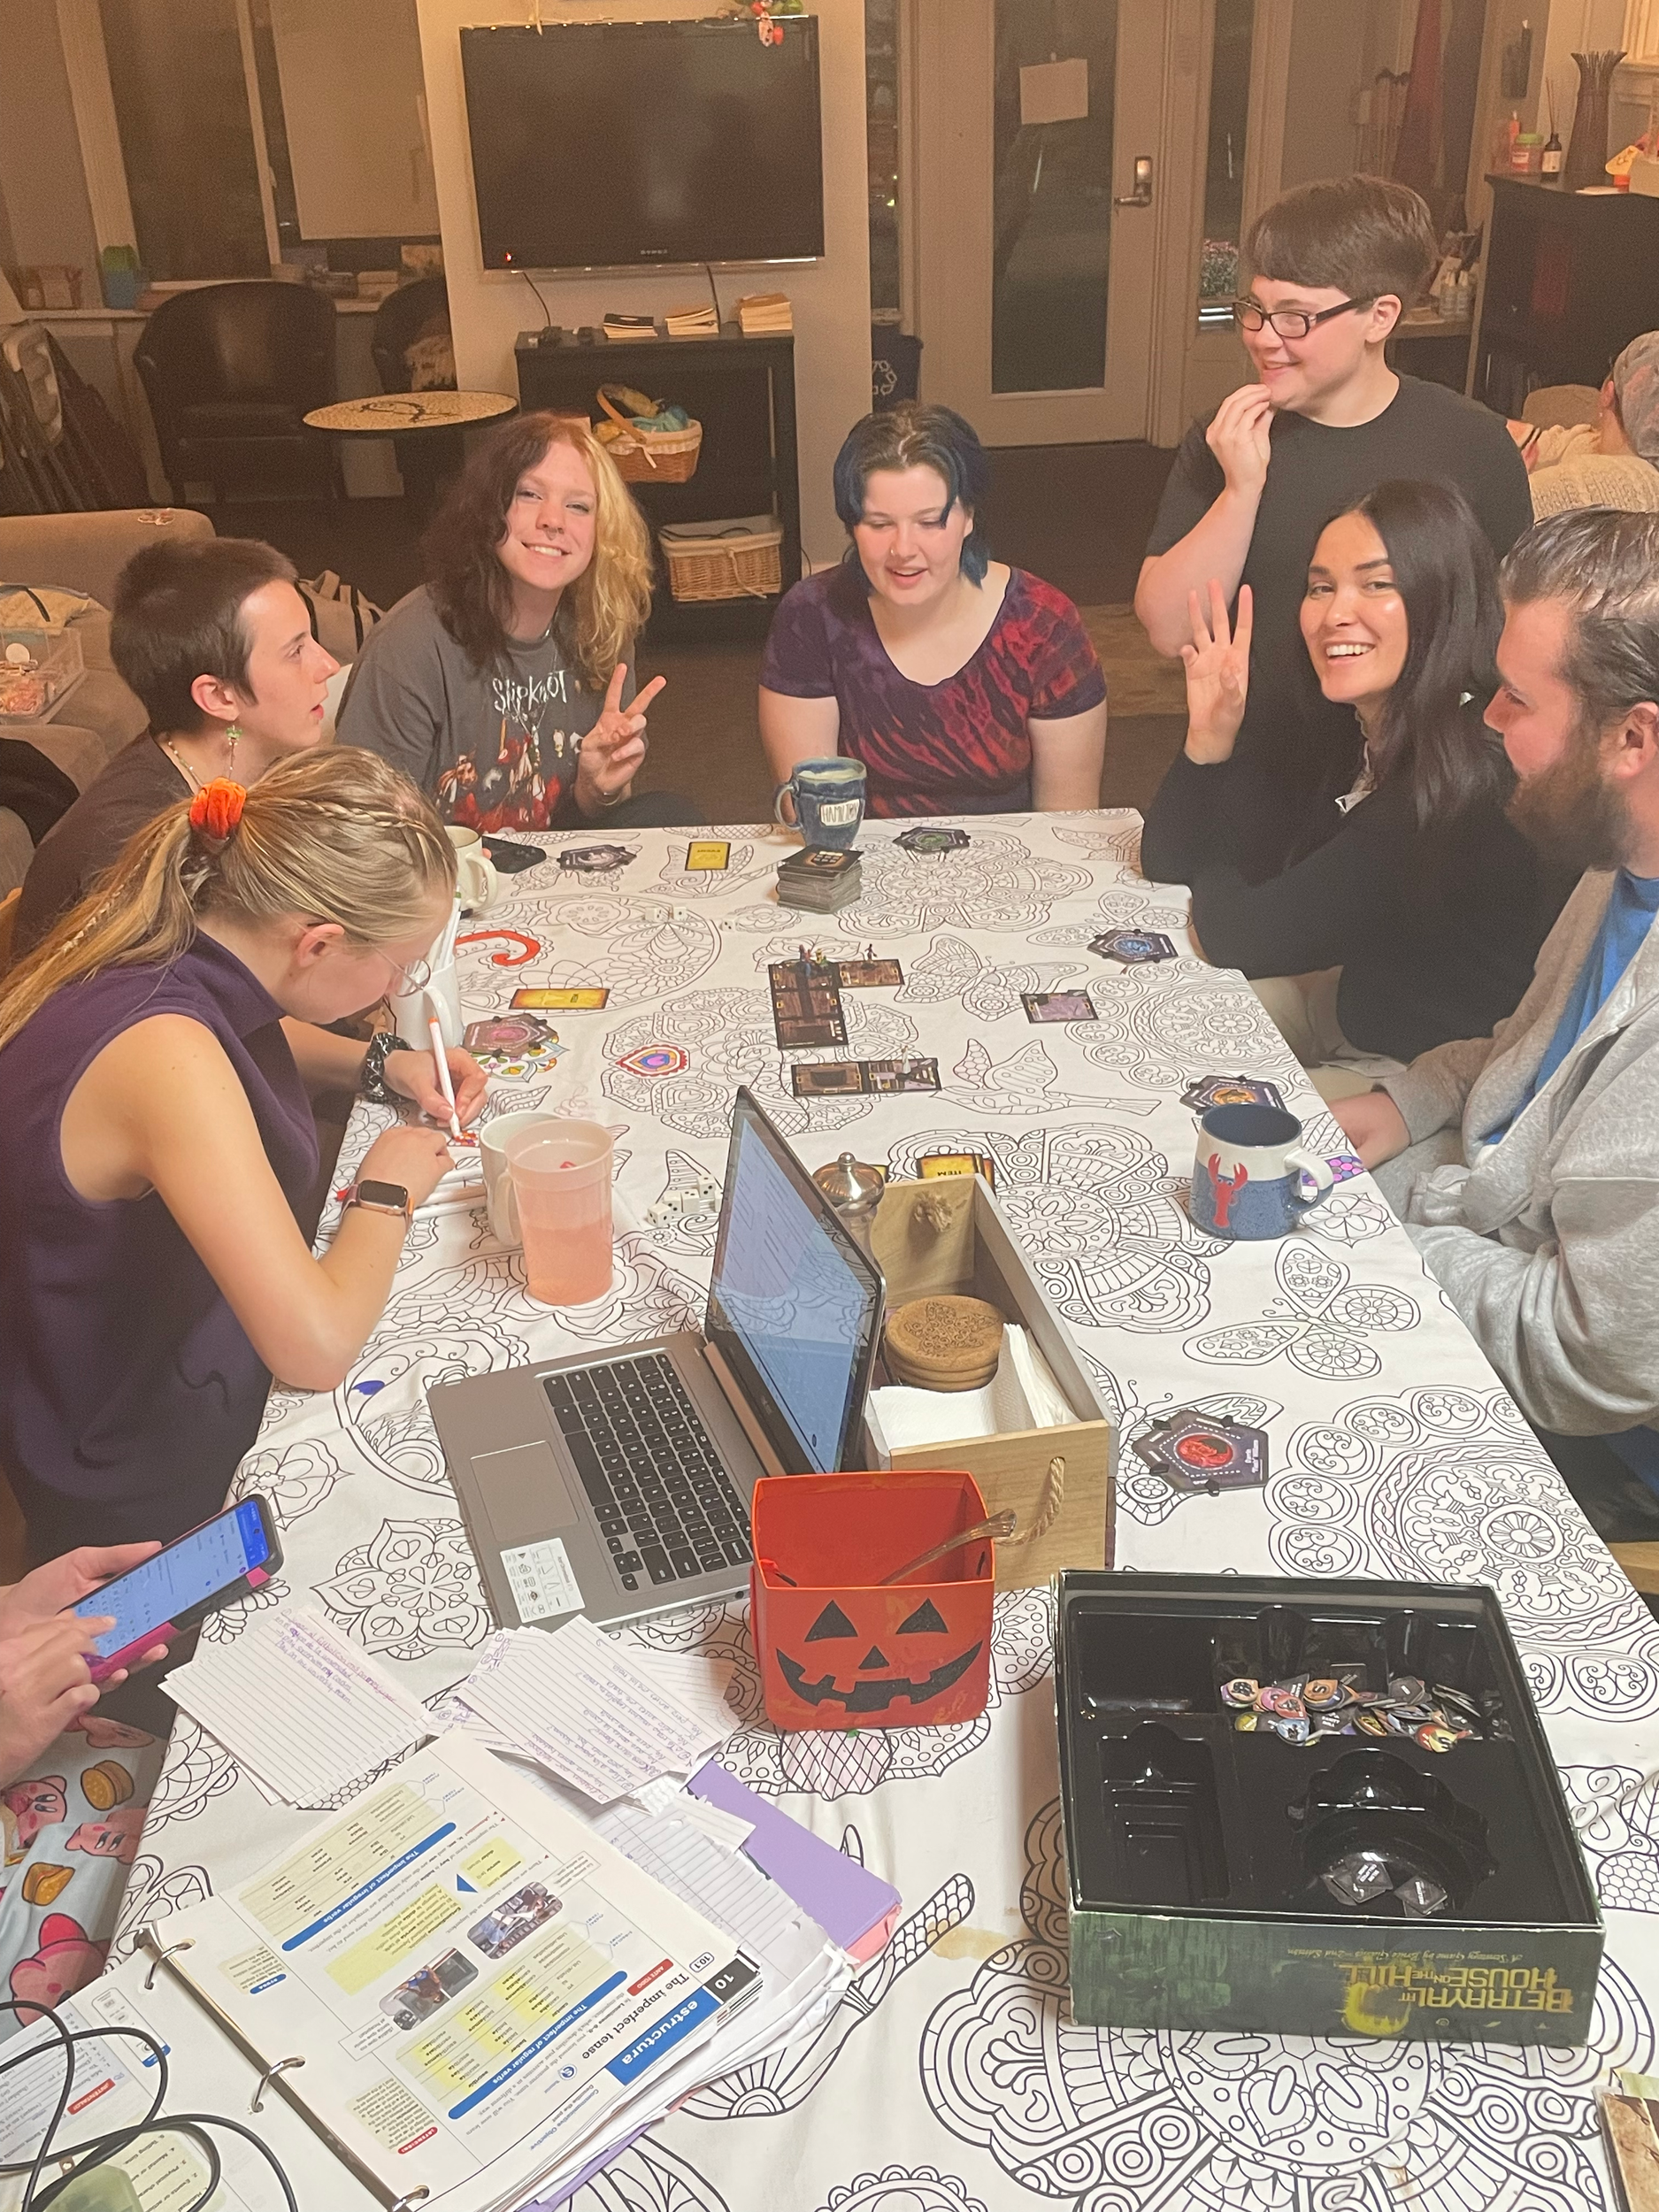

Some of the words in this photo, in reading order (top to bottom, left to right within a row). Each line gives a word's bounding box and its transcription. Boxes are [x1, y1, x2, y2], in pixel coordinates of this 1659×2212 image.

[403, 1848, 419, 1862] The
[373, 1858, 407, 1884] imperfect
[339, 1886, 370, 1910] irregular
[321, 1907, 343, 1924] verbs
[691, 1953, 712, 1970] 10.1
[1423, 1950, 1436, 1961] by
[1436, 1952, 1466, 1962] Game
[648, 1963, 665, 1978] ANTE
[1334, 1963, 1413, 1988] HILL
[1411, 1970, 1434, 1980] THE
[1433, 1974, 1451, 1985] ON
[1448, 1966, 1558, 1991] HOUSE
[634, 1974, 652, 1990] TODO
[663, 1971, 690, 1993] The
[710, 1970, 736, 1992] 10
[1398, 1992, 1417, 2002] AT
[1406, 1986, 1574, 2014] BETRAYAL
[570, 2001, 588, 2017] The
[610, 1987, 668, 2035] imperfect
[540, 2012, 576, 2042] imperfect
[619, 1998, 701, 2067] estructura
[533, 2039, 545, 2049] of
[579, 2031, 615, 2062] tense
[508, 2045, 537, 2070] regular
[490, 2065, 513, 2085] verbs
[549, 2109, 565, 2124] past
[561, 2101, 574, 2114] the
[146, 2151, 168, 2170] Mental
[154, 2164, 180, 2185] Physical
